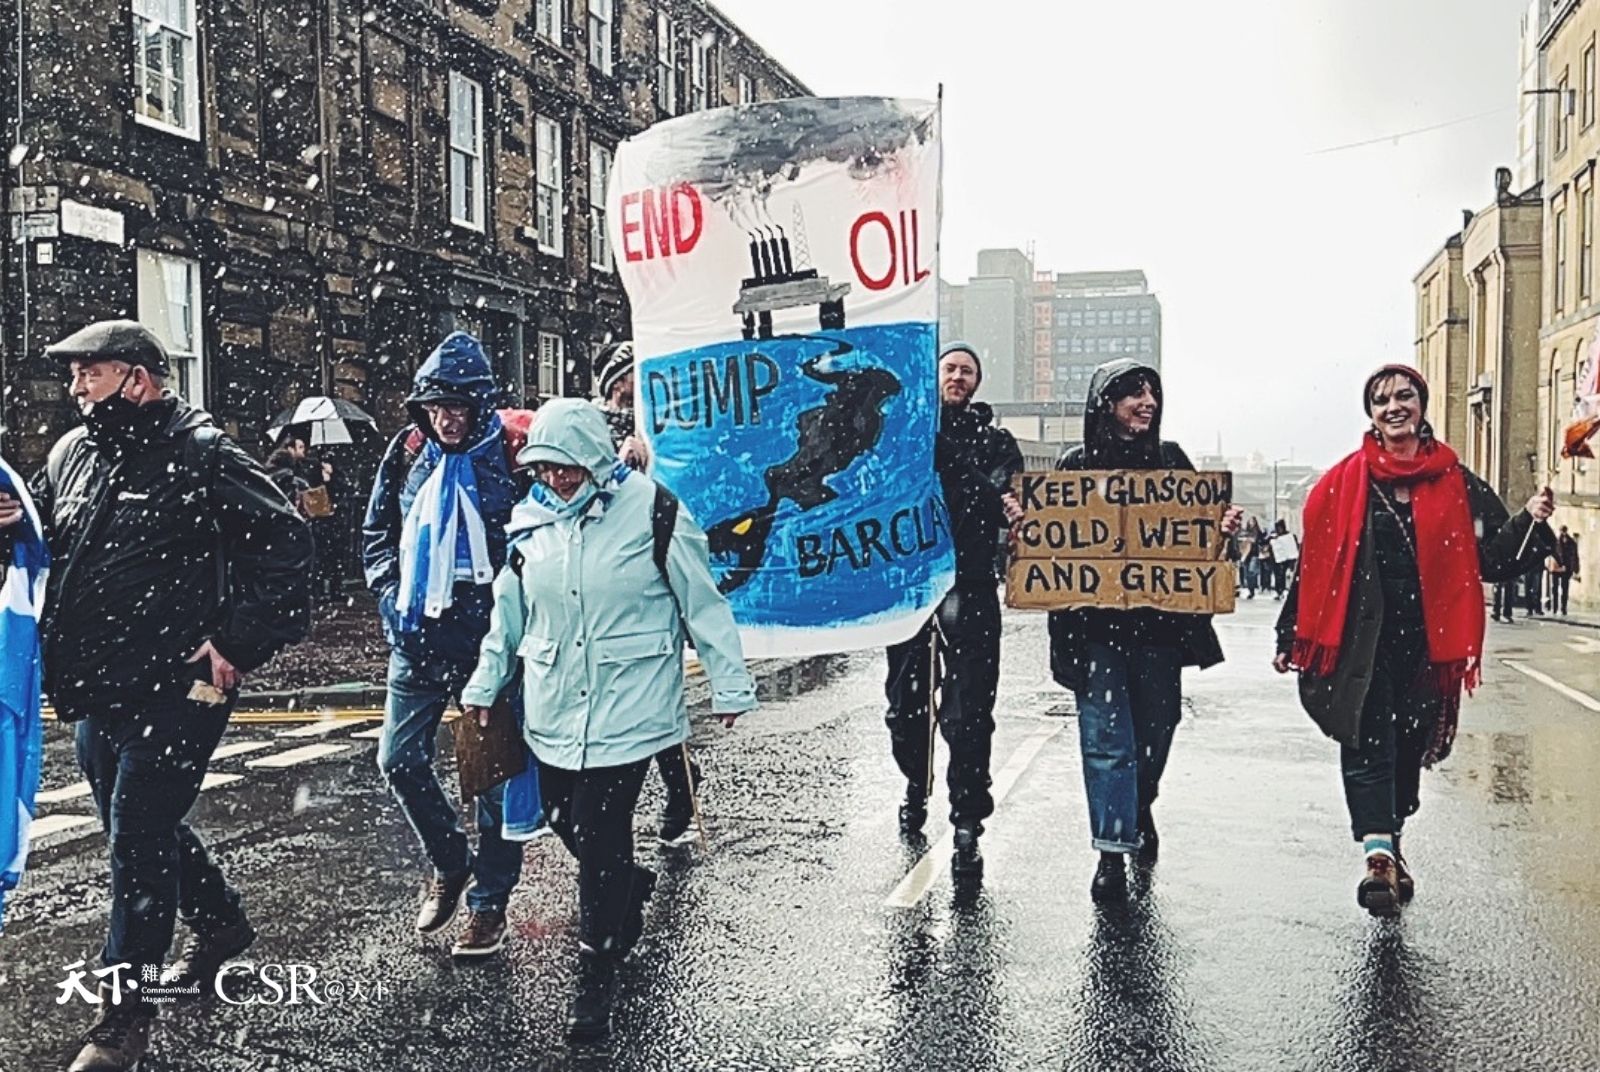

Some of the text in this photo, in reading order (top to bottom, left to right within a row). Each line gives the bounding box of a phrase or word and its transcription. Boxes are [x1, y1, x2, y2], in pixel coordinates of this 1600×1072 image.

[620, 181, 703, 262] END
[850, 211, 930, 291] OIL
[649, 352, 779, 435] DUMP
[1021, 471, 1232, 511] KEEP GLASGOW
[1021, 517, 1216, 553] COLD, WET
[1024, 562, 1217, 596] AND GREY
